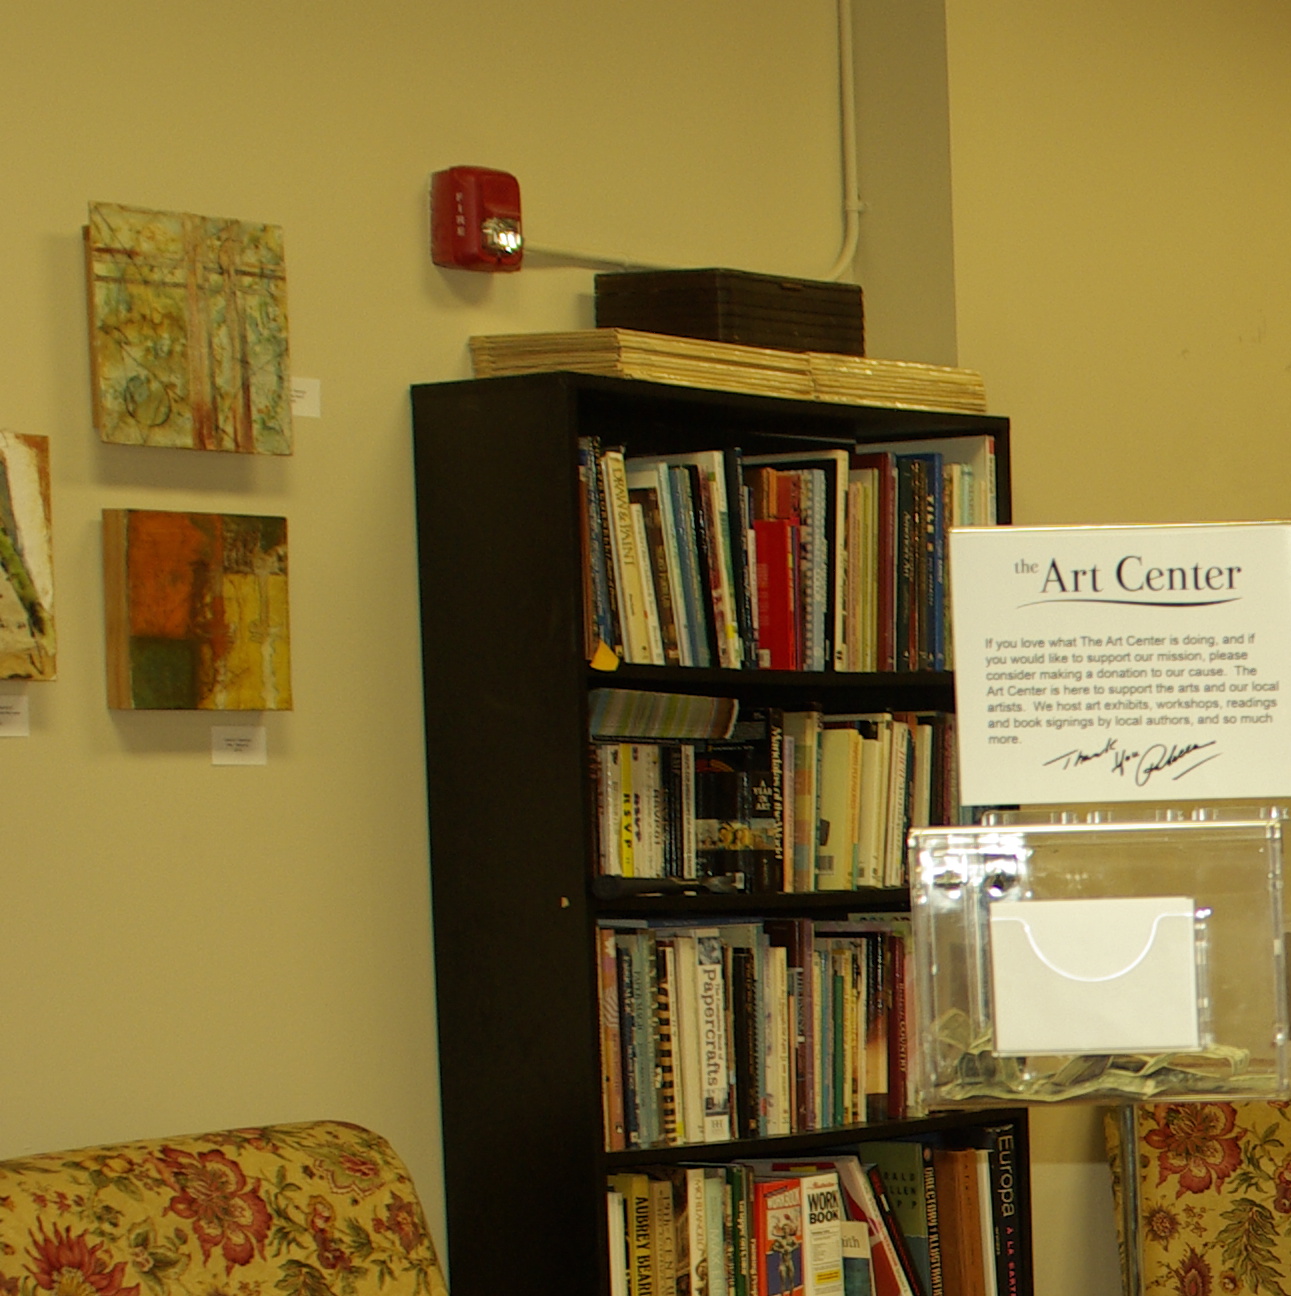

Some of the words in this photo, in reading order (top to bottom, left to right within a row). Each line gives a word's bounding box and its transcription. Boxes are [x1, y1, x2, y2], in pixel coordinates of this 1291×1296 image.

[455, 191, 466, 237] FIRE
[612, 468, 627, 508] DRAW
[620, 524, 635, 566] PAINT
[1015, 559, 1039, 575] the
[1040, 558, 1104, 593] Art
[1116, 555, 1242, 592] Center
[985, 638, 994, 649] If
[995, 639, 1017, 651] you
[1021, 637, 1045, 647] love
[1048, 637, 1077, 647] what
[1081, 636, 1103, 647] The
[1106, 636, 1123, 646] Art
[1126, 635, 1166, 646] Center
[1169, 635, 1179, 645] is
[1183, 634, 1218, 647] doing,
[1222, 633, 1245, 644] and
[1247, 633, 1255, 644] if
[985, 656, 1007, 666] you
[1010, 653, 1045, 664] would
[1049, 652, 1068, 664] like
[1072, 653, 1083, 663] to
[1087, 652, 1131, 665] support
[1134, 652, 1154, 662] our
[1157, 650, 1206, 663] mission,
[1209, 650, 1248, 662] please
[986, 669, 1037, 680] consider
[1040, 668, 1082, 682] making
[1086, 670, 1093, 678] a
[1096, 667, 1147, 679] donation
[1151, 668, 1162, 678] to
[1165, 668, 1185, 677] our
[1188, 667, 1227, 677] cause.
[1235, 666, 1257, 676] The
[986, 685, 1004, 696] Art
[1007, 684, 1047, 696] Center
[1050, 685, 1060, 695] is
[1063, 684, 1090, 695] here
[1093, 684, 1105, 695] to
[1108, 683, 1153, 697] support
[1156, 682, 1174, 693] the
[1178, 683, 1200, 693] arts
[1204, 682, 1226, 693] and
[1229, 683, 1249, 692] our
[1251, 681, 1279, 692] local
[988, 701, 1026, 713] artists.
[1033, 700, 1053, 711] We
[1057, 700, 1082, 711] host
[1085, 700, 1101, 710] art
[1104, 699, 1153, 712] exhibits,
[1155, 698, 1223, 712] workshops,
[1226, 697, 1277, 711] readings
[988, 717, 1010, 728] and
[1014, 716, 1042, 728] book
[1045, 715, 1094, 730] signings
[1098, 716, 1112, 729] by
[1115, 715, 1142, 726] local
[1146, 714, 1194, 727] authors,
[1197, 714, 1220, 725] and
[1223, 715, 1237, 725] so
[1240, 713, 1273, 724] much
[989, 735, 1022, 745] more.
[1043, 738, 1117, 771] Thank
[623, 793, 631, 848] RSVP
[701, 968, 720, 1087] Papercrafts
[718, 1053, 724, 1061] of
[997, 1135, 1015, 1218] Europa
[808, 1191, 838, 1211] WORK
[635, 1197, 650, 1251] AUBREY
[694, 1179, 703, 1252] MICHELANGELO
[809, 1212, 839, 1225] BOOK
[709, 1229, 720, 1264] MAX
